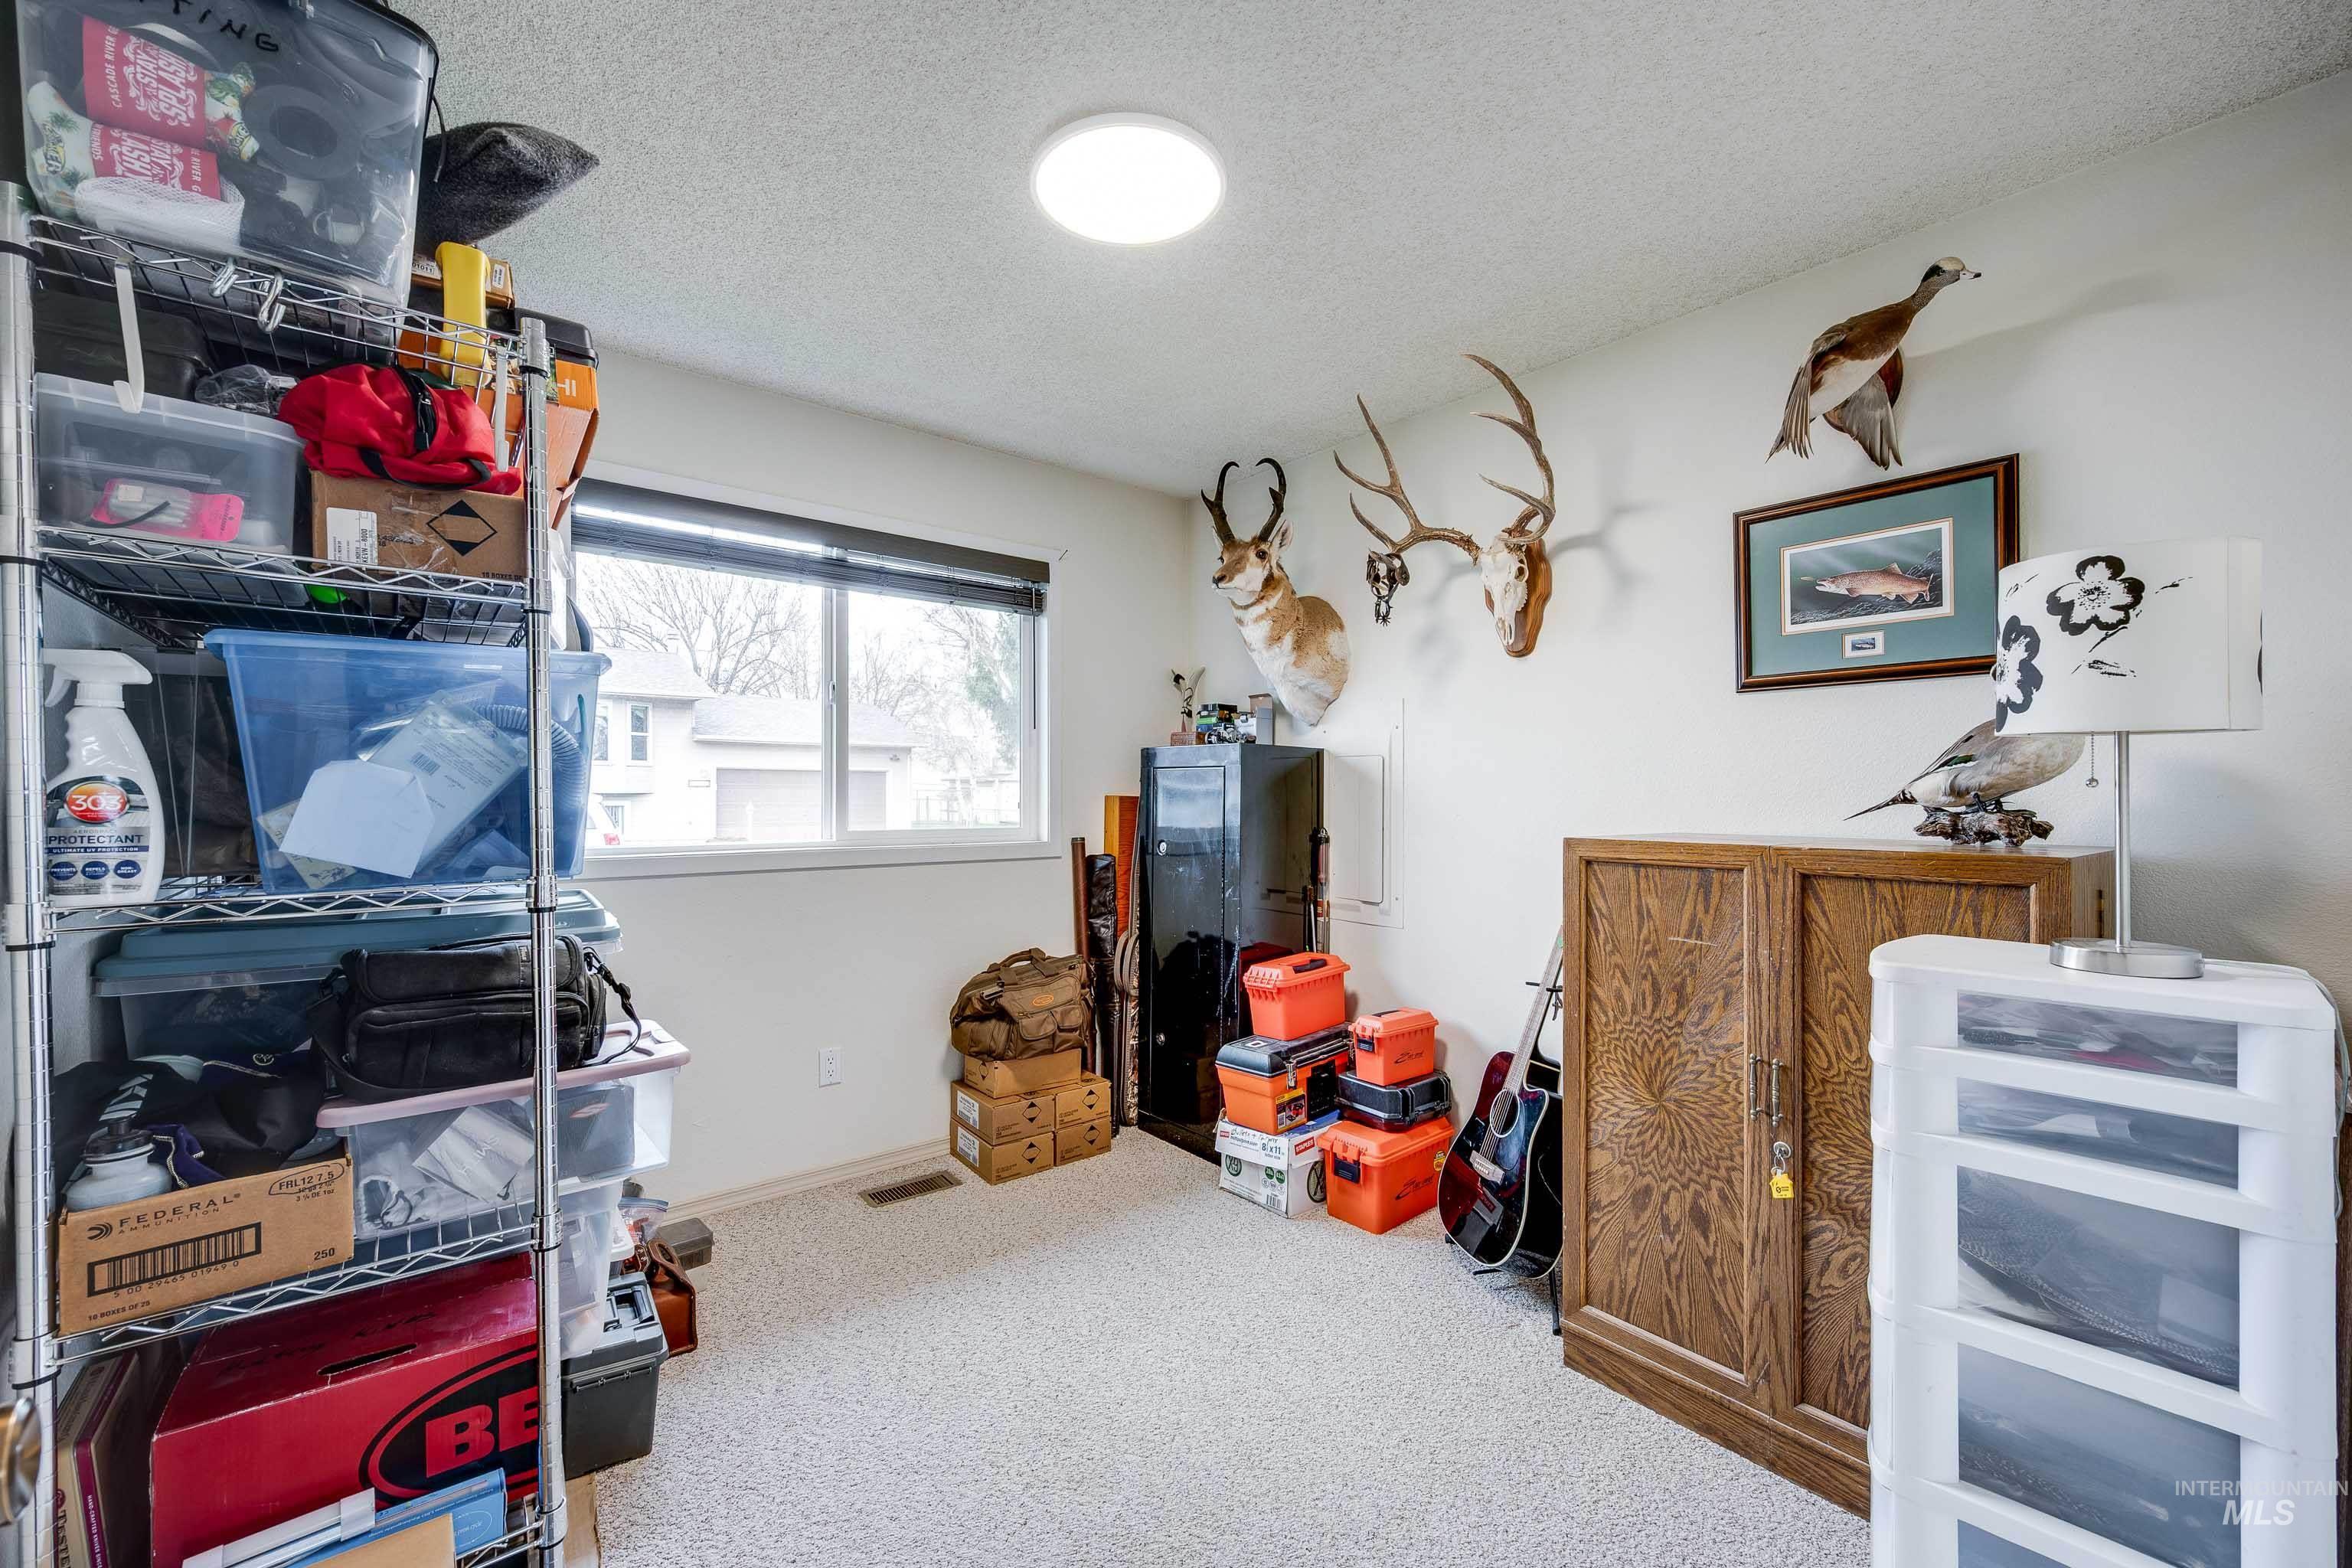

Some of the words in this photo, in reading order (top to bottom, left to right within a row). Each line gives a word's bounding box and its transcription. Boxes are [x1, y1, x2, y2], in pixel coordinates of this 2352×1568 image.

[103, 35, 116, 61] RIVER
[136, 49, 158, 88] STAY
[104, 63, 122, 109] CASCADE
[191, 157, 201, 182] RIVER
[71, 795, 122, 811] 303
[48, 835, 144, 844] PROTECTANT
[279, 1175, 313, 1191] FRL12
[318, 1171, 335, 1182] 7.5
[119, 1194, 234, 1228] FEDERAL
[119, 1207, 220, 1235] AMMUNITION
[314, 1247, 335, 1261] 250
[148, 1274, 185, 1290] 29465
[191, 1263, 227, 1279] 01949
[88, 1313, 99, 1321] 10
[100, 1306, 126, 1318] BOXES
[426, 1386, 540, 1478] BE
[87, 1494, 99, 1532] HAND-CRAFTED
[57, 1509, 72, 1568] TESTE
